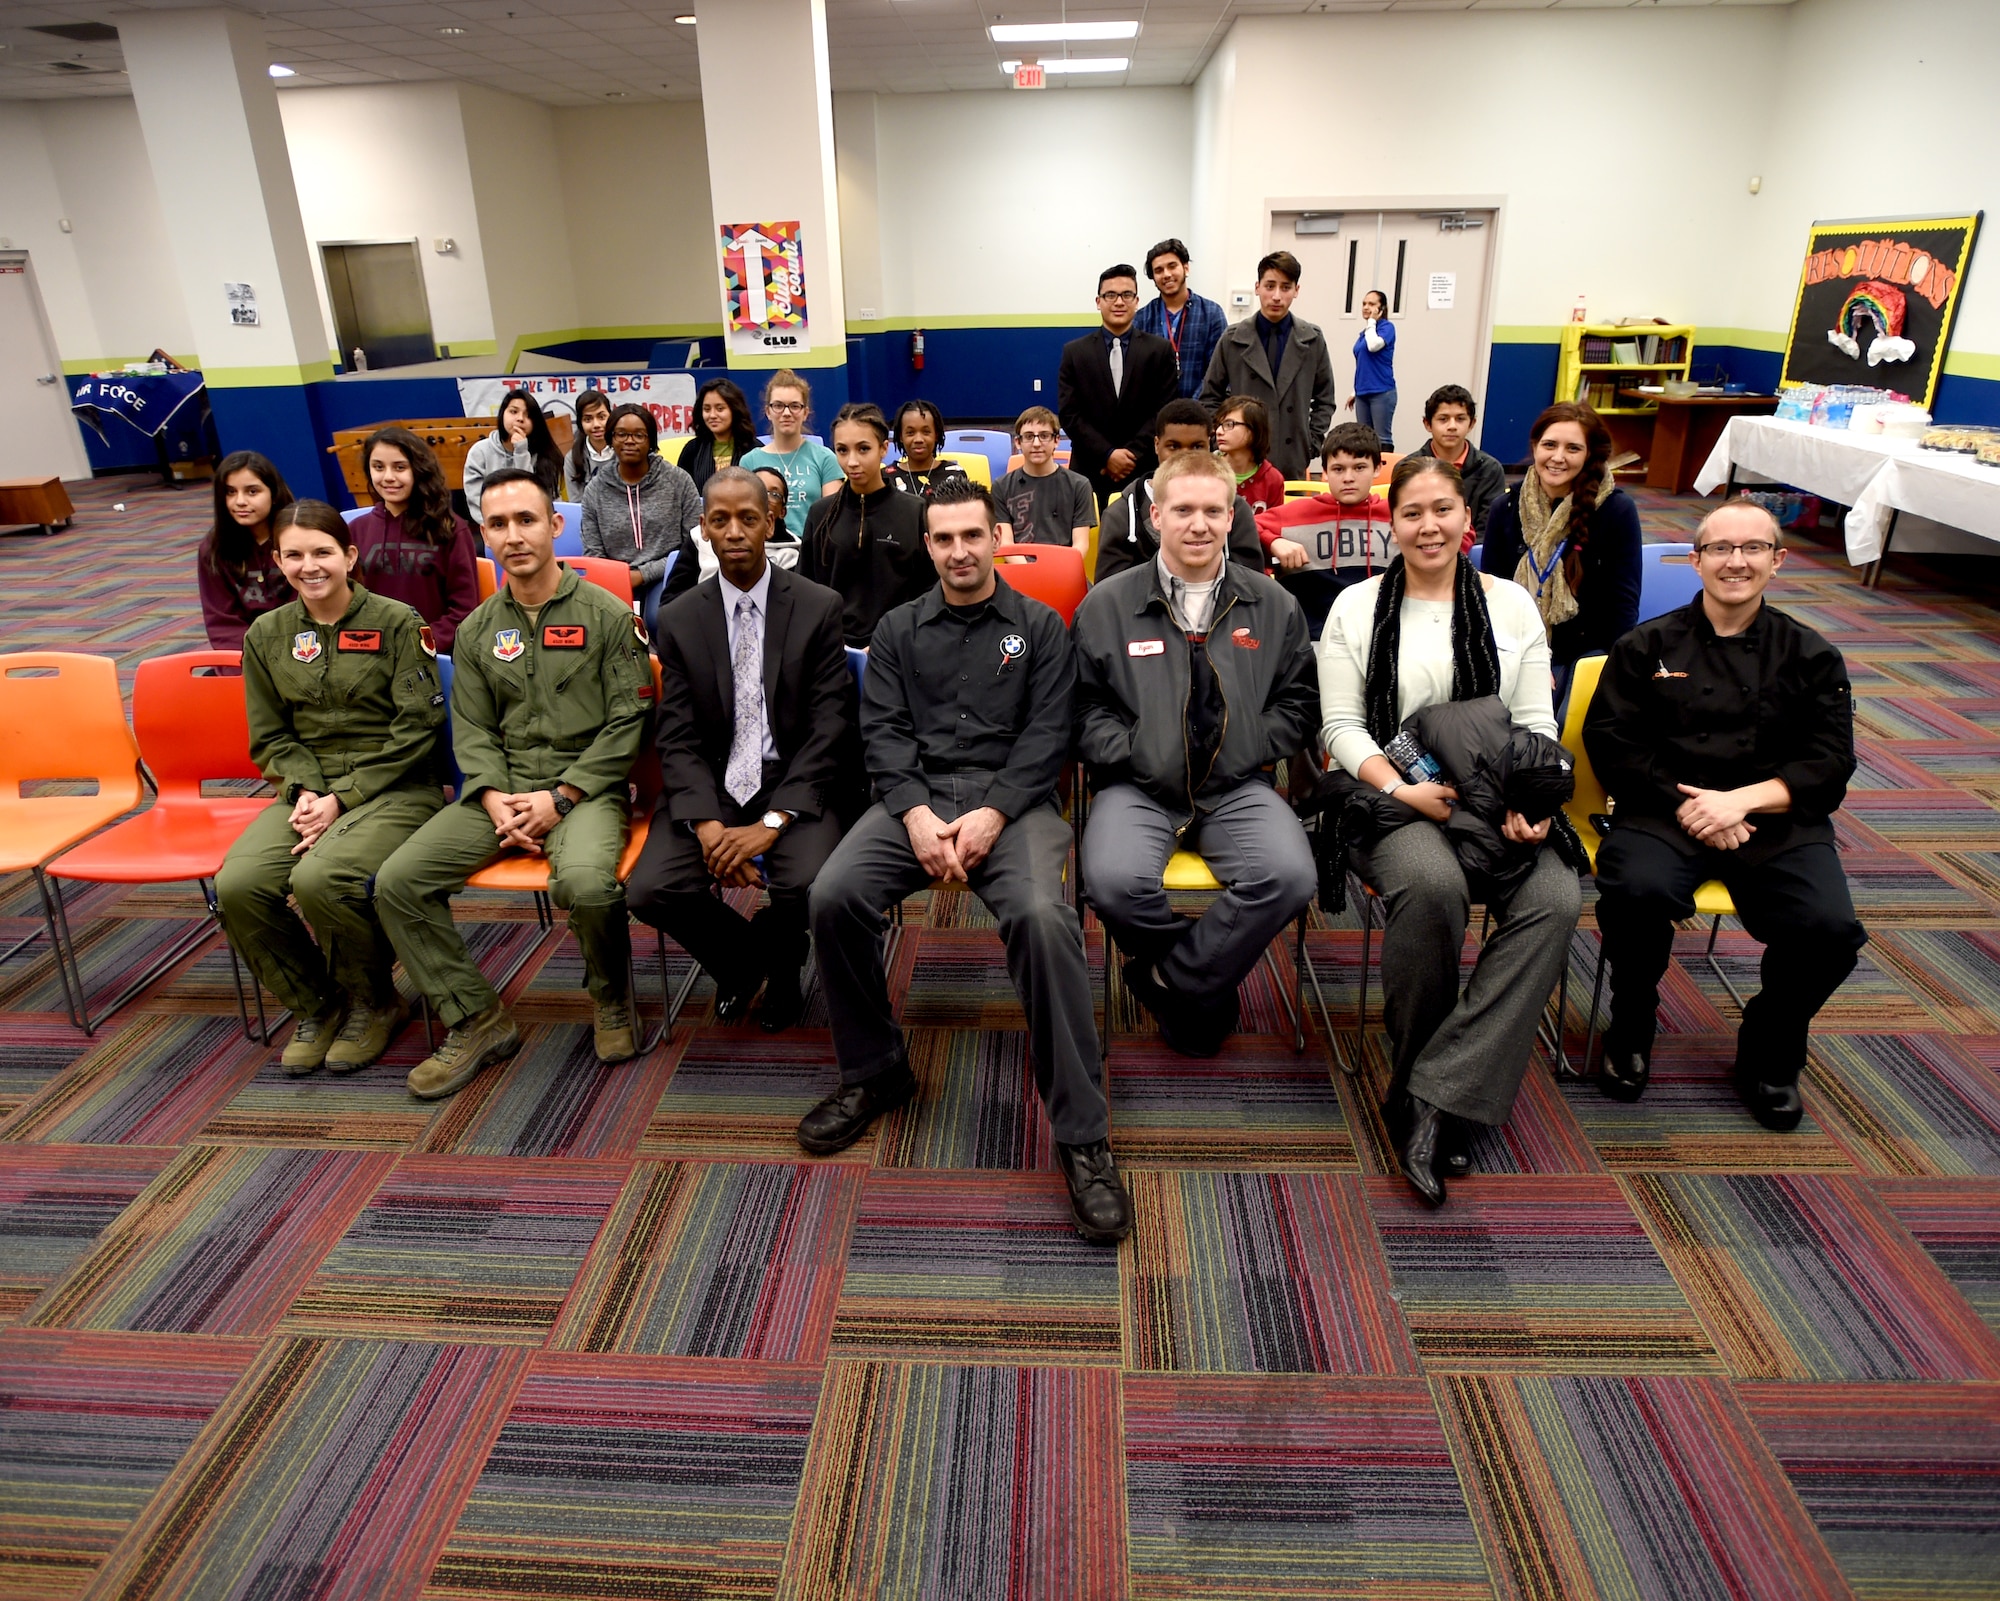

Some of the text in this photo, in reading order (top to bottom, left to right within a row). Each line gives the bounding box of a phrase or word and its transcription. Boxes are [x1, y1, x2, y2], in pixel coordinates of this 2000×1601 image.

[1019, 70, 1041, 86] EXIT
[1807, 243, 1952, 304] RESOLUTIONS
[763, 336, 797, 346] CLUB
[99, 384, 147, 412] FORCE
[502, 375, 651, 395] TAKE THE PLEDGE
[1316, 528, 1393, 560] OBEY
[363, 542, 439, 577] VANS
